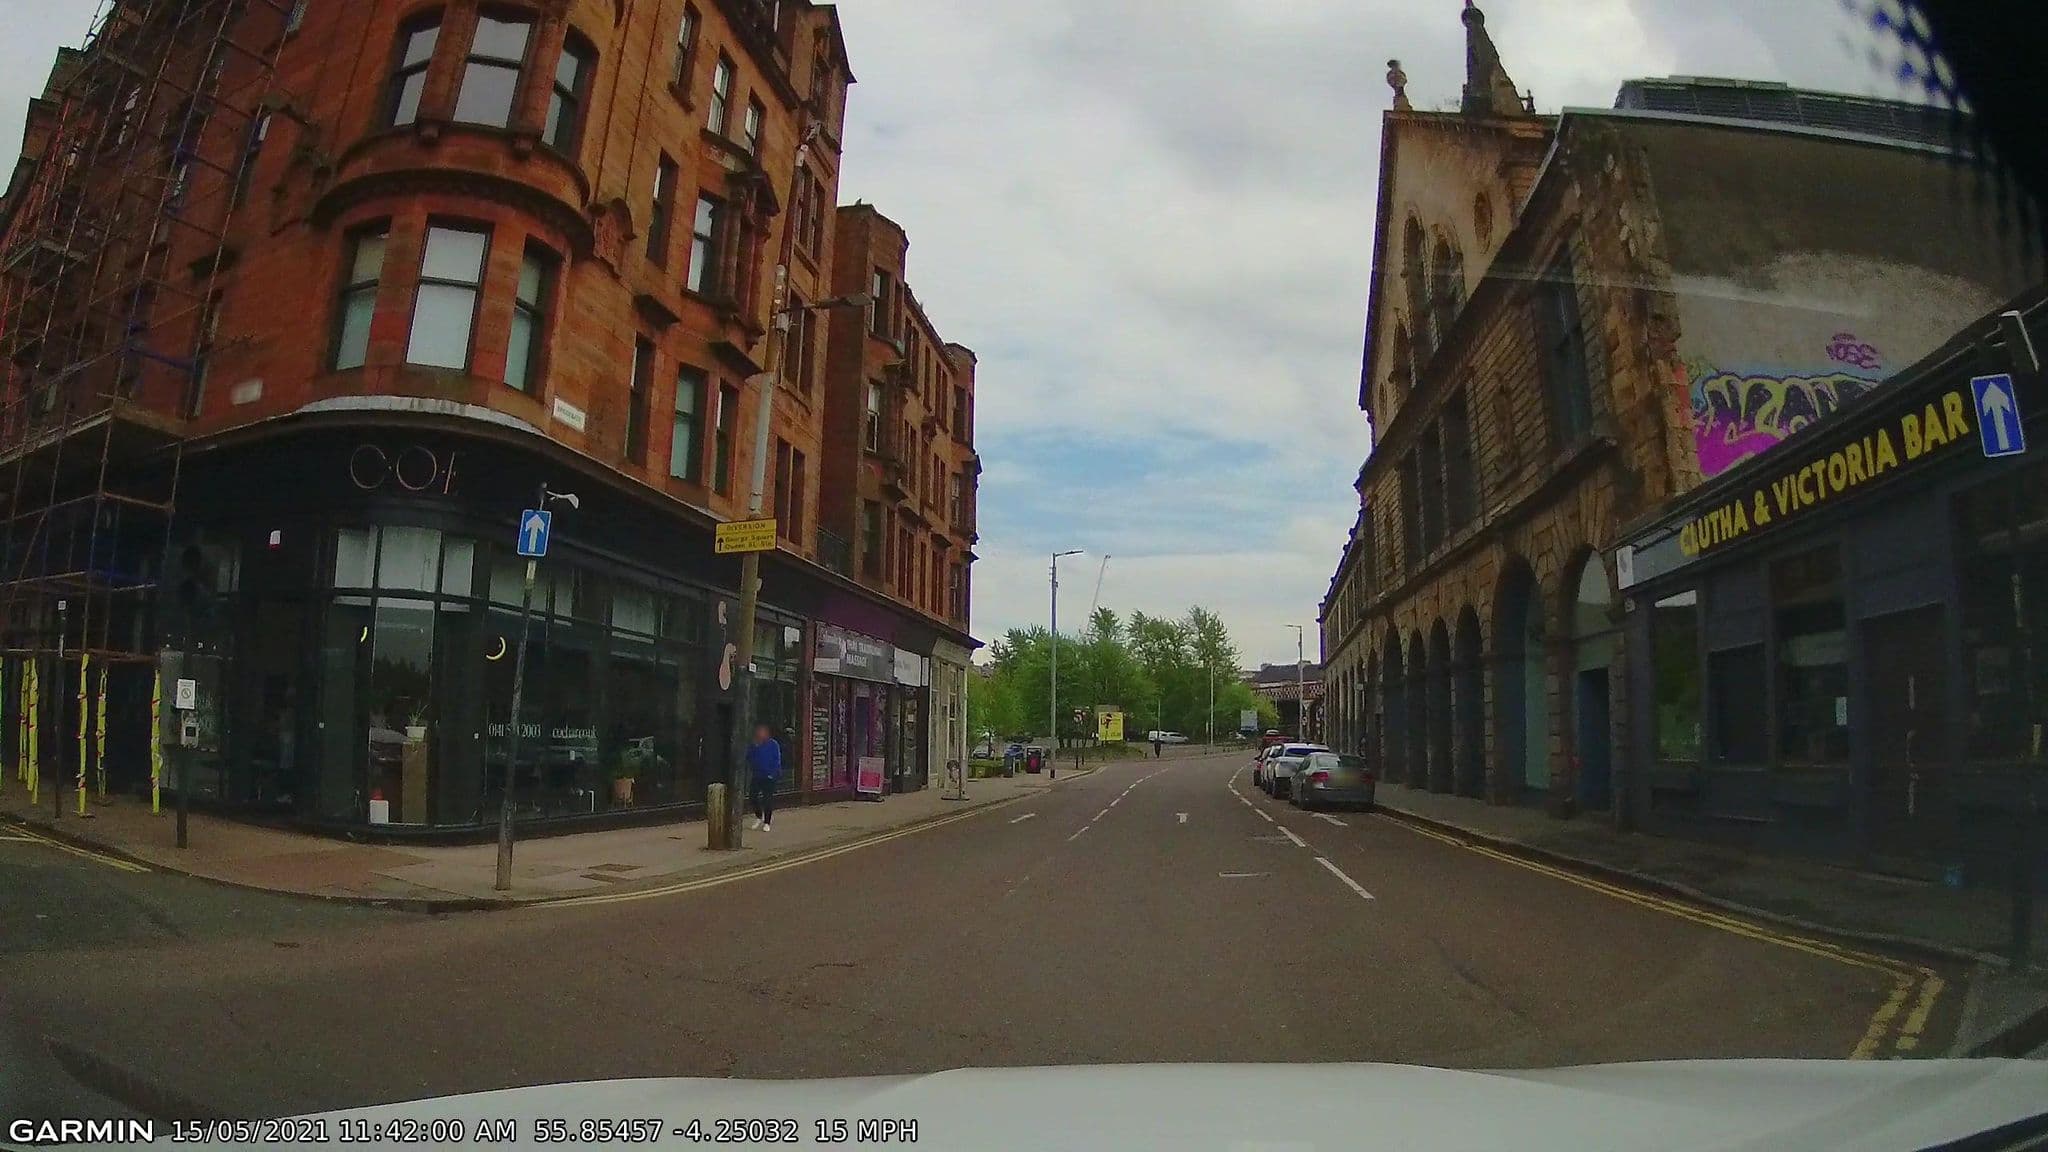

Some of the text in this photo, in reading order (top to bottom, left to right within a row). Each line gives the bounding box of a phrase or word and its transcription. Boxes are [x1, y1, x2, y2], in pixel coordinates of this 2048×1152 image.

[1681, 499, 1749, 556] CLUTHA
[1754, 490, 1771, 526] &
[1772, 428, 1898, 515] VICTORIA
[1901, 391, 1969, 460] BAR
[726, 522, 766, 531] DIVERSION
